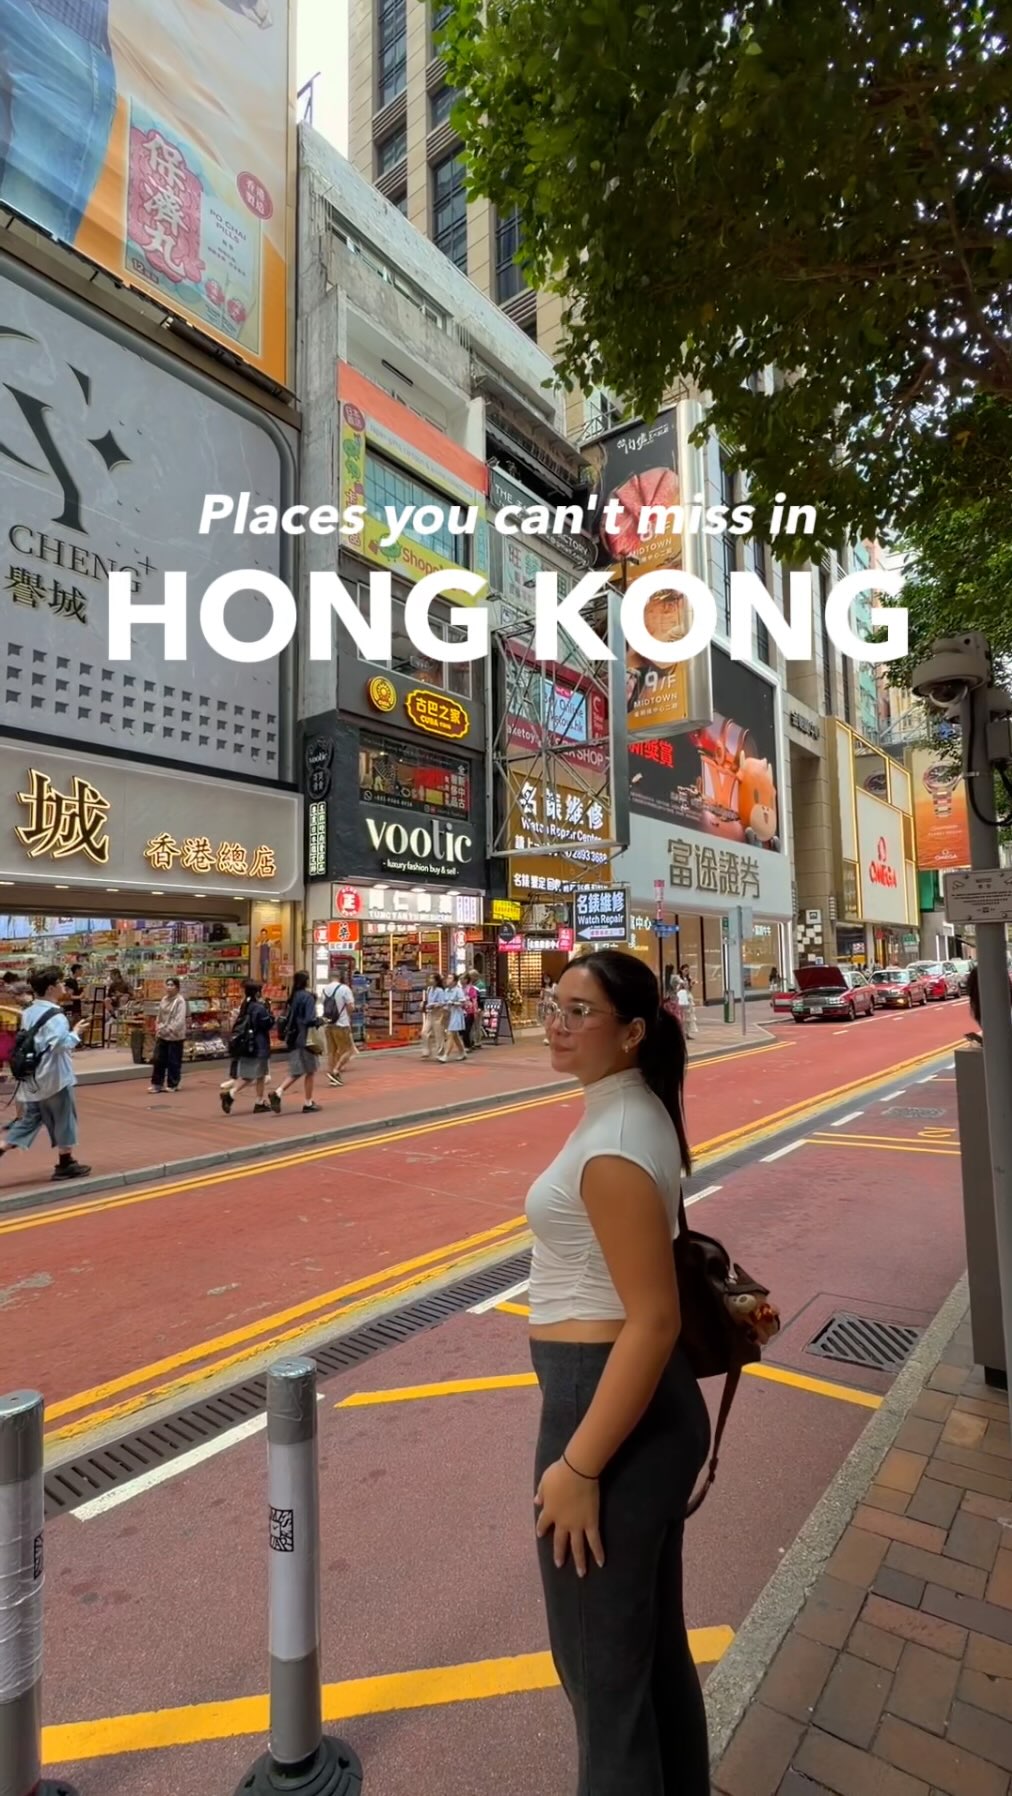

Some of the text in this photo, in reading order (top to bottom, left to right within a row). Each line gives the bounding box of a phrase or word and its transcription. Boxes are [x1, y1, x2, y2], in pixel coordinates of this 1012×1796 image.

[3, 564, 87, 624] 譽城
[645, 670, 676, 693] 9/F
[416, 697, 461, 725] 古巴之家
[634, 693, 678, 708] MIDTOWN
[16, 768, 110, 863] 城
[143, 832, 277, 877] 香港總店
[387, 859, 407, 872] luxury
[407, 861, 429, 872] fashion
[429, 864, 441, 875] buy
[667, 838, 760, 900] 富途證券
[869, 861, 897, 888] OMEGA
[577, 891, 624, 914] 名錶維修
[577, 913, 624, 926] Watch Repair
